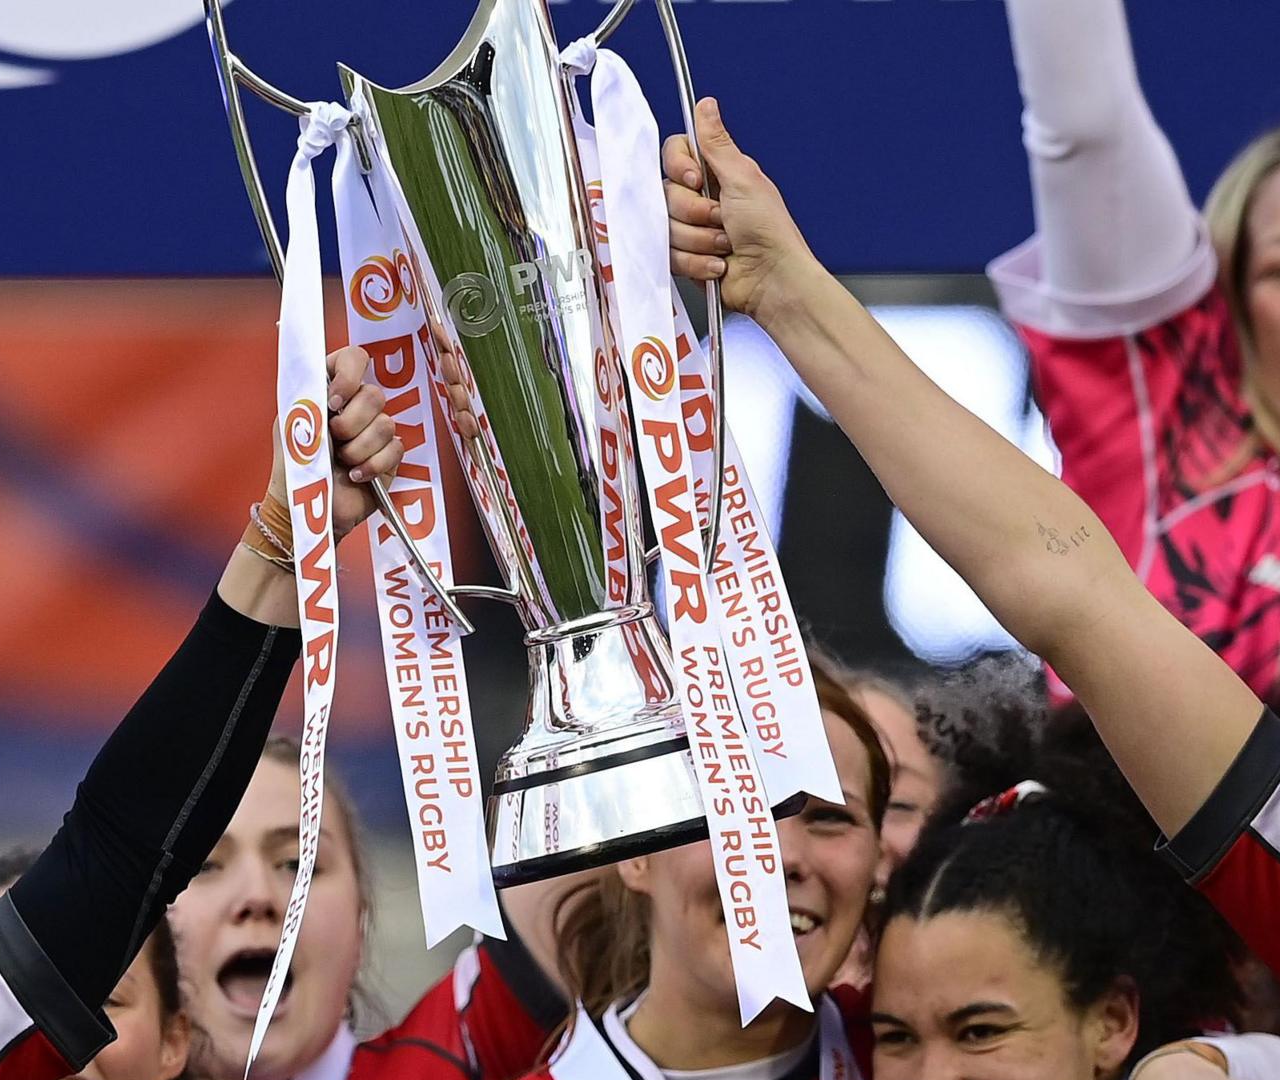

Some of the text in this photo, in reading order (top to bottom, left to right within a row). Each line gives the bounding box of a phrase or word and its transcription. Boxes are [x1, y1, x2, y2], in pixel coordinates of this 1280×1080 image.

[510, 248, 594, 295] PWR
[293, 478, 335, 695] PWR
[642, 418, 708, 625] PWR
[722, 464, 804, 688] PREMIERSHIP
[383, 564, 452, 874] WOMEN'S RUGBY
[680, 646, 762, 951] WOMEN'S RUGBY
[703, 646, 776, 875] PREMIERSHIP
[740, 656, 788, 760] RUGBY
